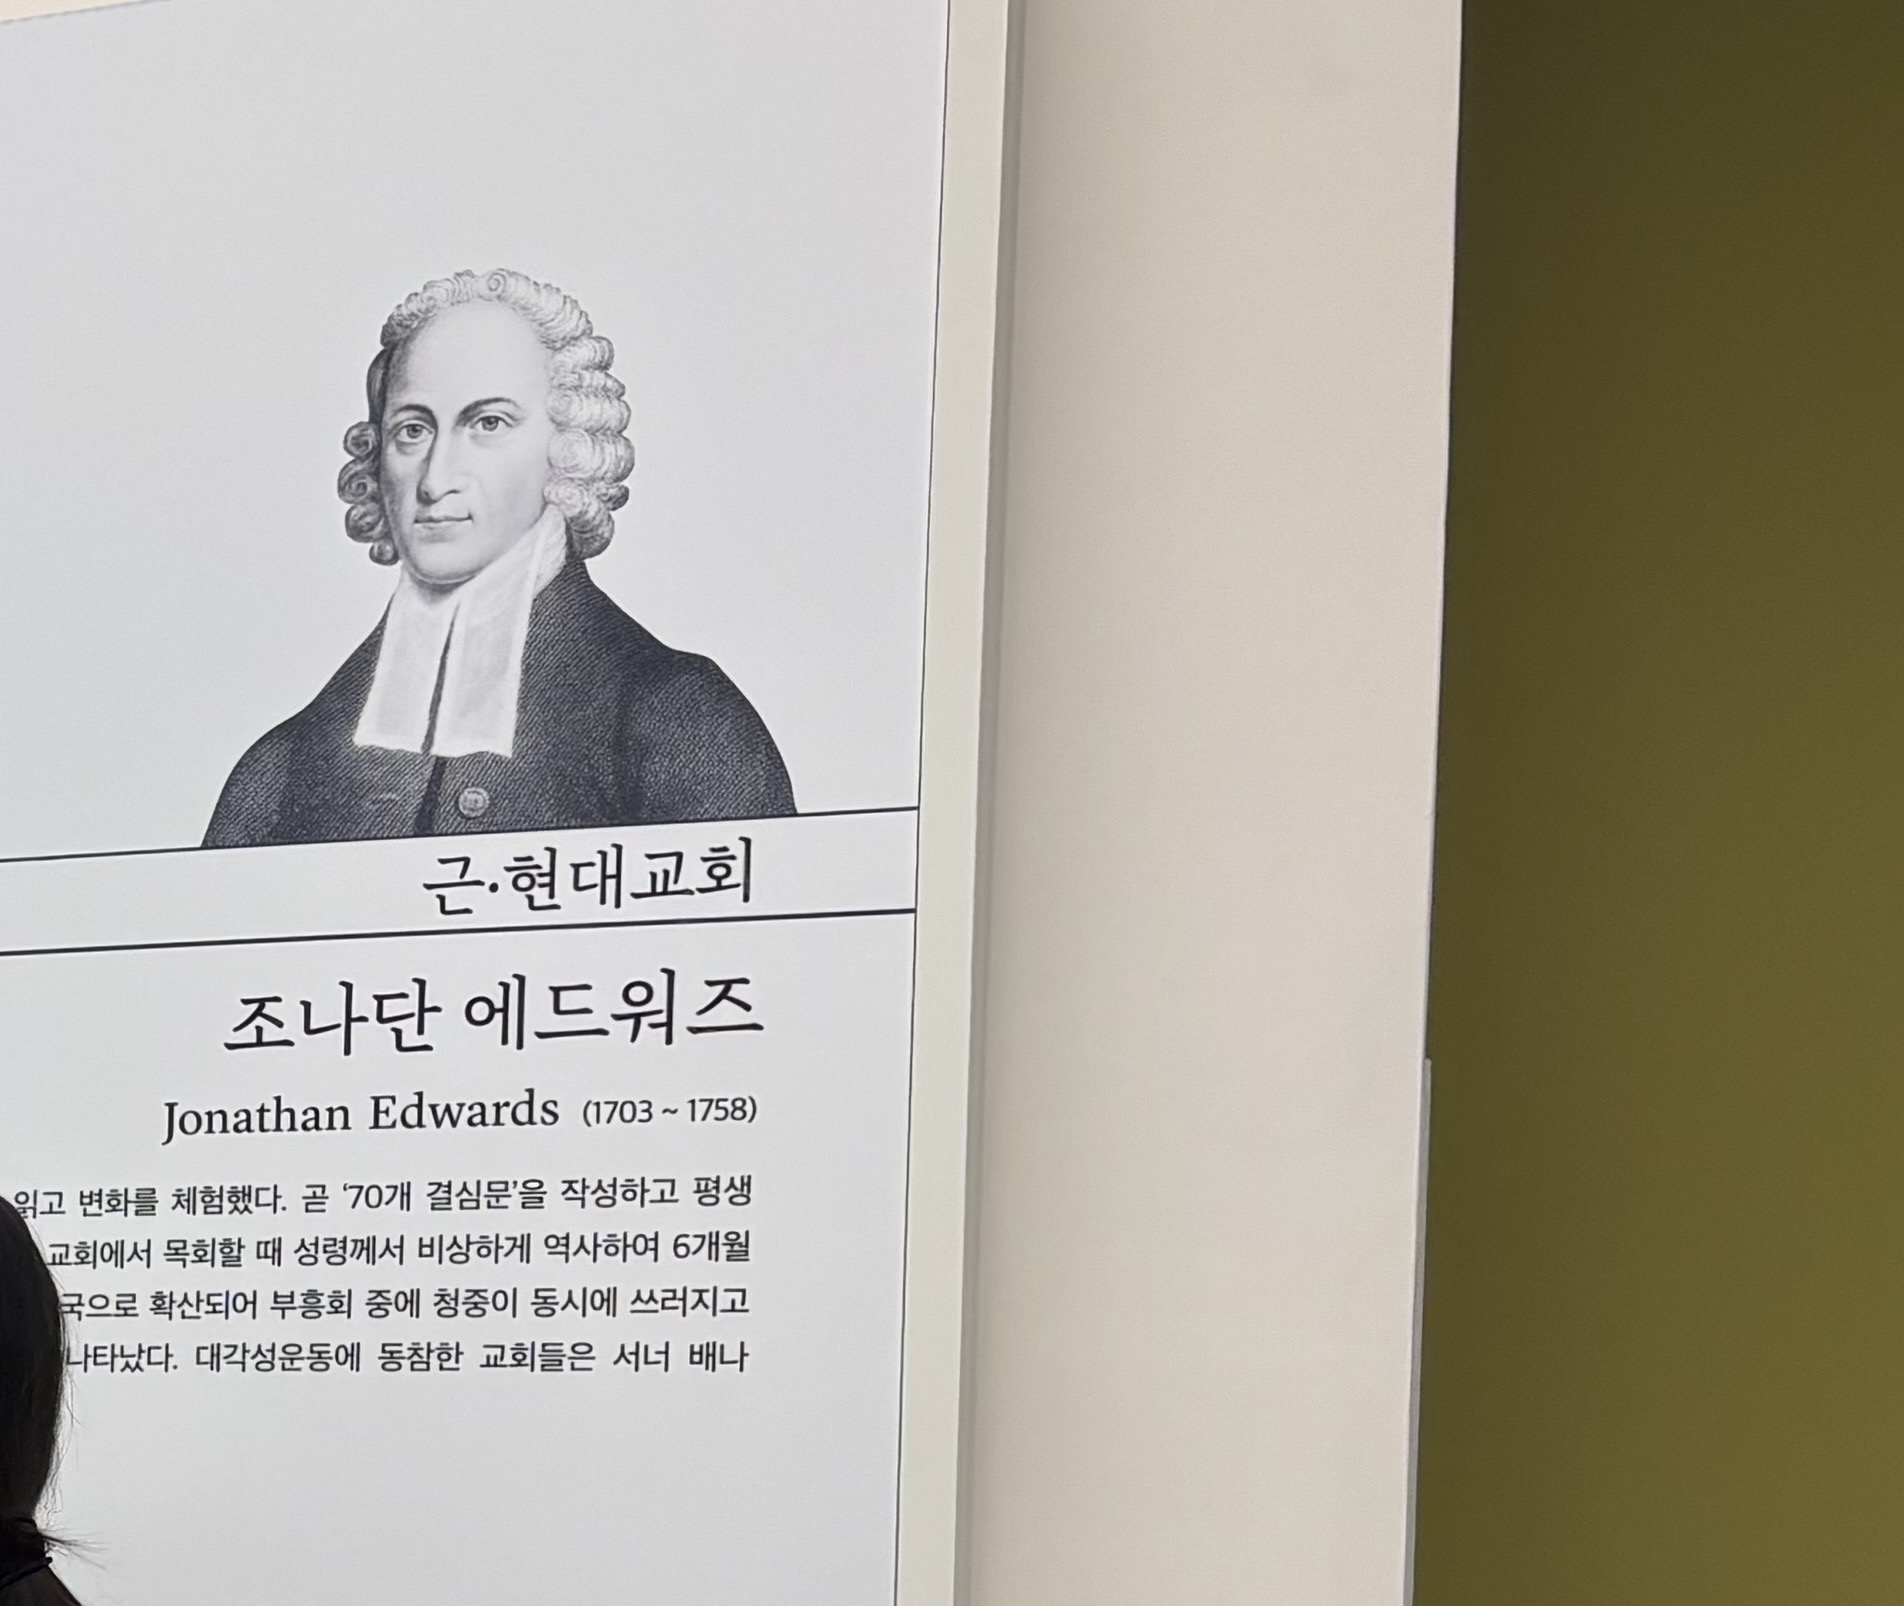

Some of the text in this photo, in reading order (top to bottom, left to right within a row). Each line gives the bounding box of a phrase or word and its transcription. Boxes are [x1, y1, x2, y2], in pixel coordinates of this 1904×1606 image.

[422, 835, 752, 913] 근·현대교회
[223, 967, 765, 1054] 조나단 에드워즈
[161, 1094, 352, 1147] Jonathan
[368, 1087, 560, 1130] Edwards
[79, 1187, 160, 1218] 변화를
[171, 1183, 287, 1217] 체험했다.
[301, 1183, 330, 1214] 곧
[560, 1176, 680, 1210] 작성하고
[692, 1174, 752, 1207] 평생
[47, 1229, 751, 1271] 교회에서 목회할 때 성령께서 비상하게 역사하여 6개월
[148, 1289, 258, 1322] 확산되어
[269, 1288, 353, 1321] 부흥회
[364, 1287, 421, 1320] 중에
[433, 1286, 518, 1319] 청중이
[530, 1286, 618, 1319] 동시에
[629, 1285, 750, 1318] 쓰러지고
[65, 1338, 750, 1376] 나타났다. 대각성운동에 동참한 교회들은 서너 배나
